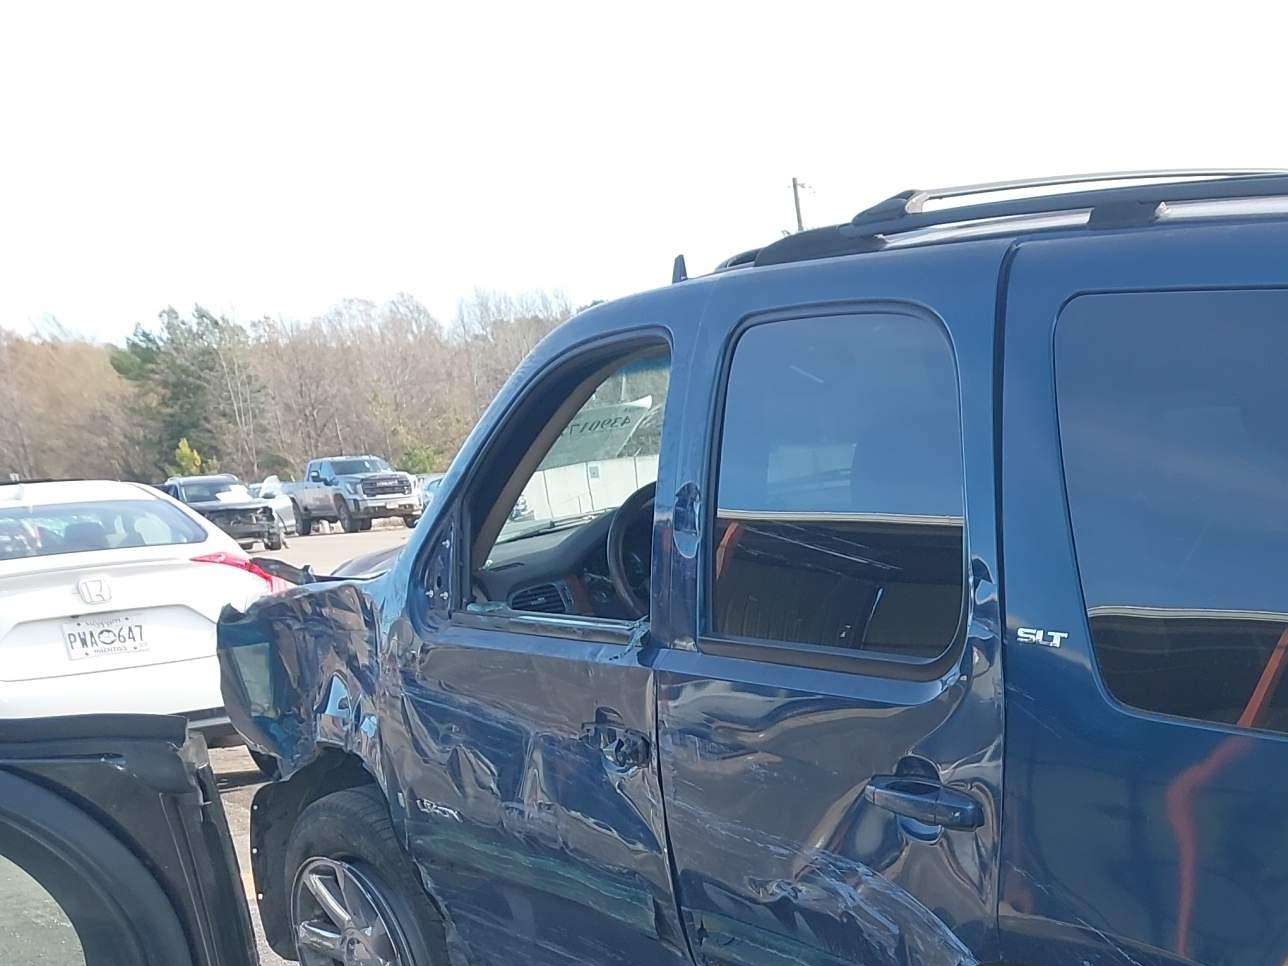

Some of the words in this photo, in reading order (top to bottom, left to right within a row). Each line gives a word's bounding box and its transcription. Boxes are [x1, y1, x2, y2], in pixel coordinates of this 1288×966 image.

[68, 631, 98, 649] PWA
[118, 625, 143, 643] 647
[1017, 628, 1069, 648] SLT
